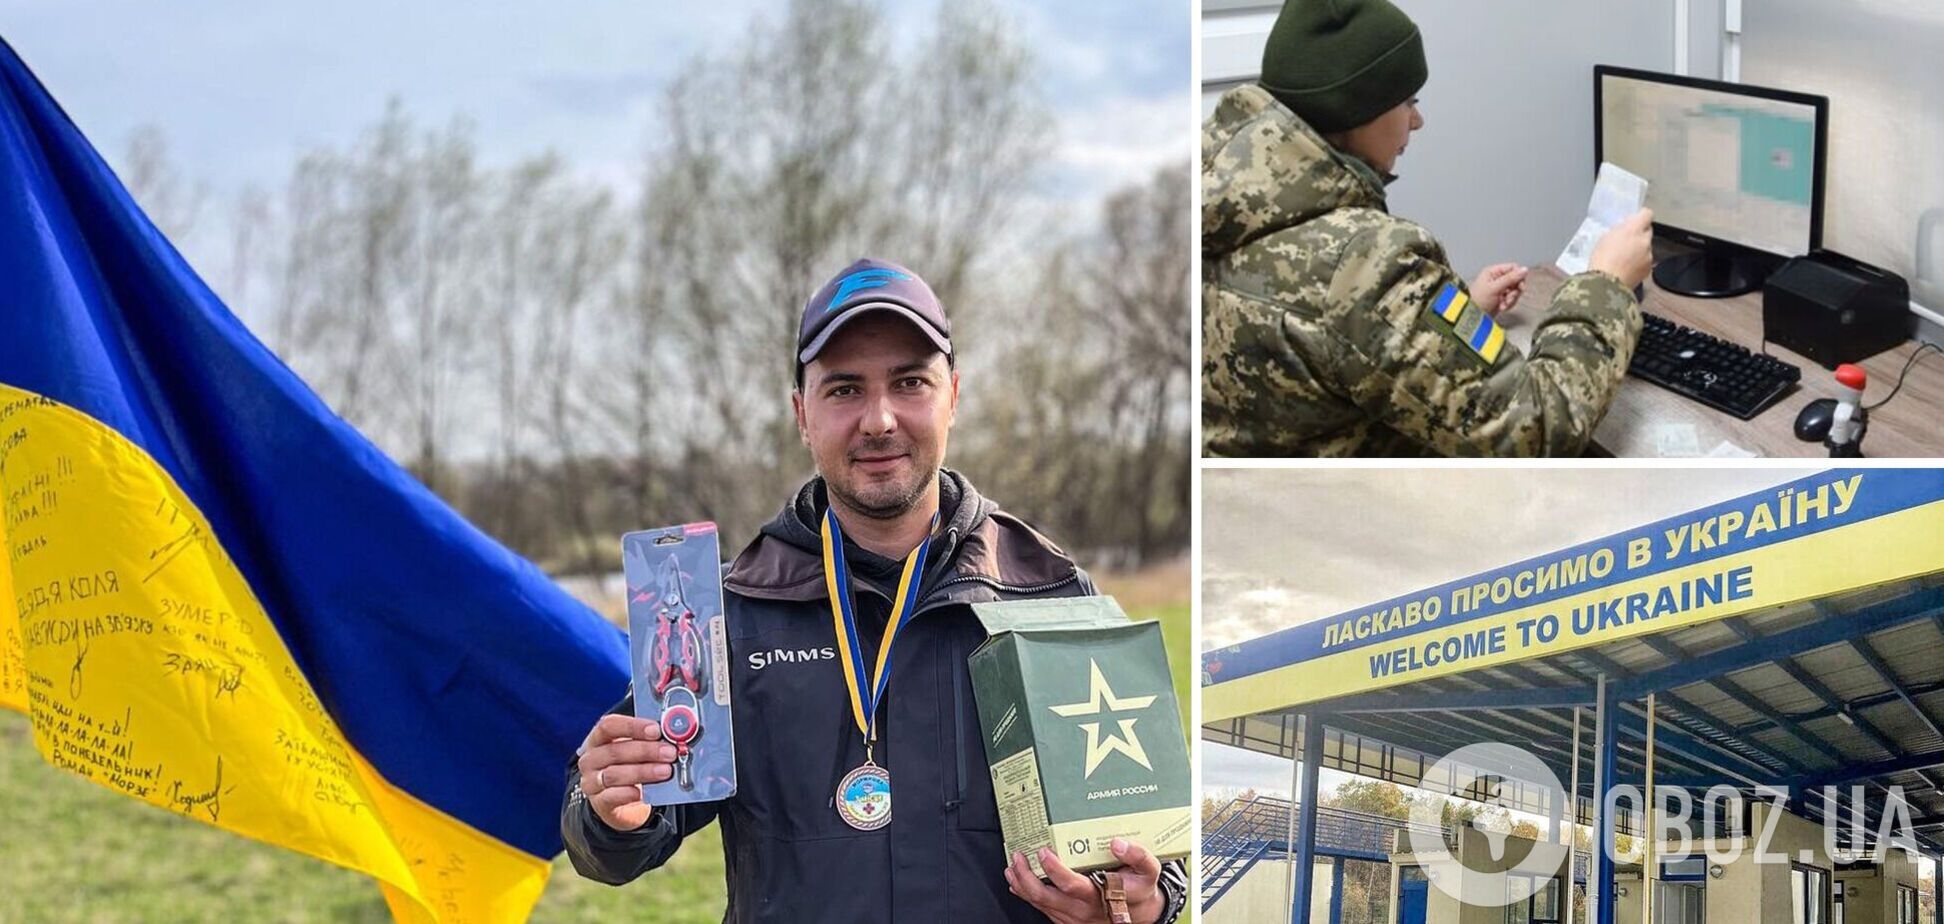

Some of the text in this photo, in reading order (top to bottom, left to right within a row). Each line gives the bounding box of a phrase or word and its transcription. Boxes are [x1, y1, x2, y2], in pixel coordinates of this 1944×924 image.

[1321, 473, 1864, 648] ЛАСКАВО ПРОСИМО В УКРАЇНУ
[69, 570, 119, 601] КОЛЯ
[1368, 565, 1753, 679] WELCOME TO UKRAINE
[748, 647, 836, 670] SIMMS
[1087, 784, 1158, 800] АРМИЯ РОССИИ
